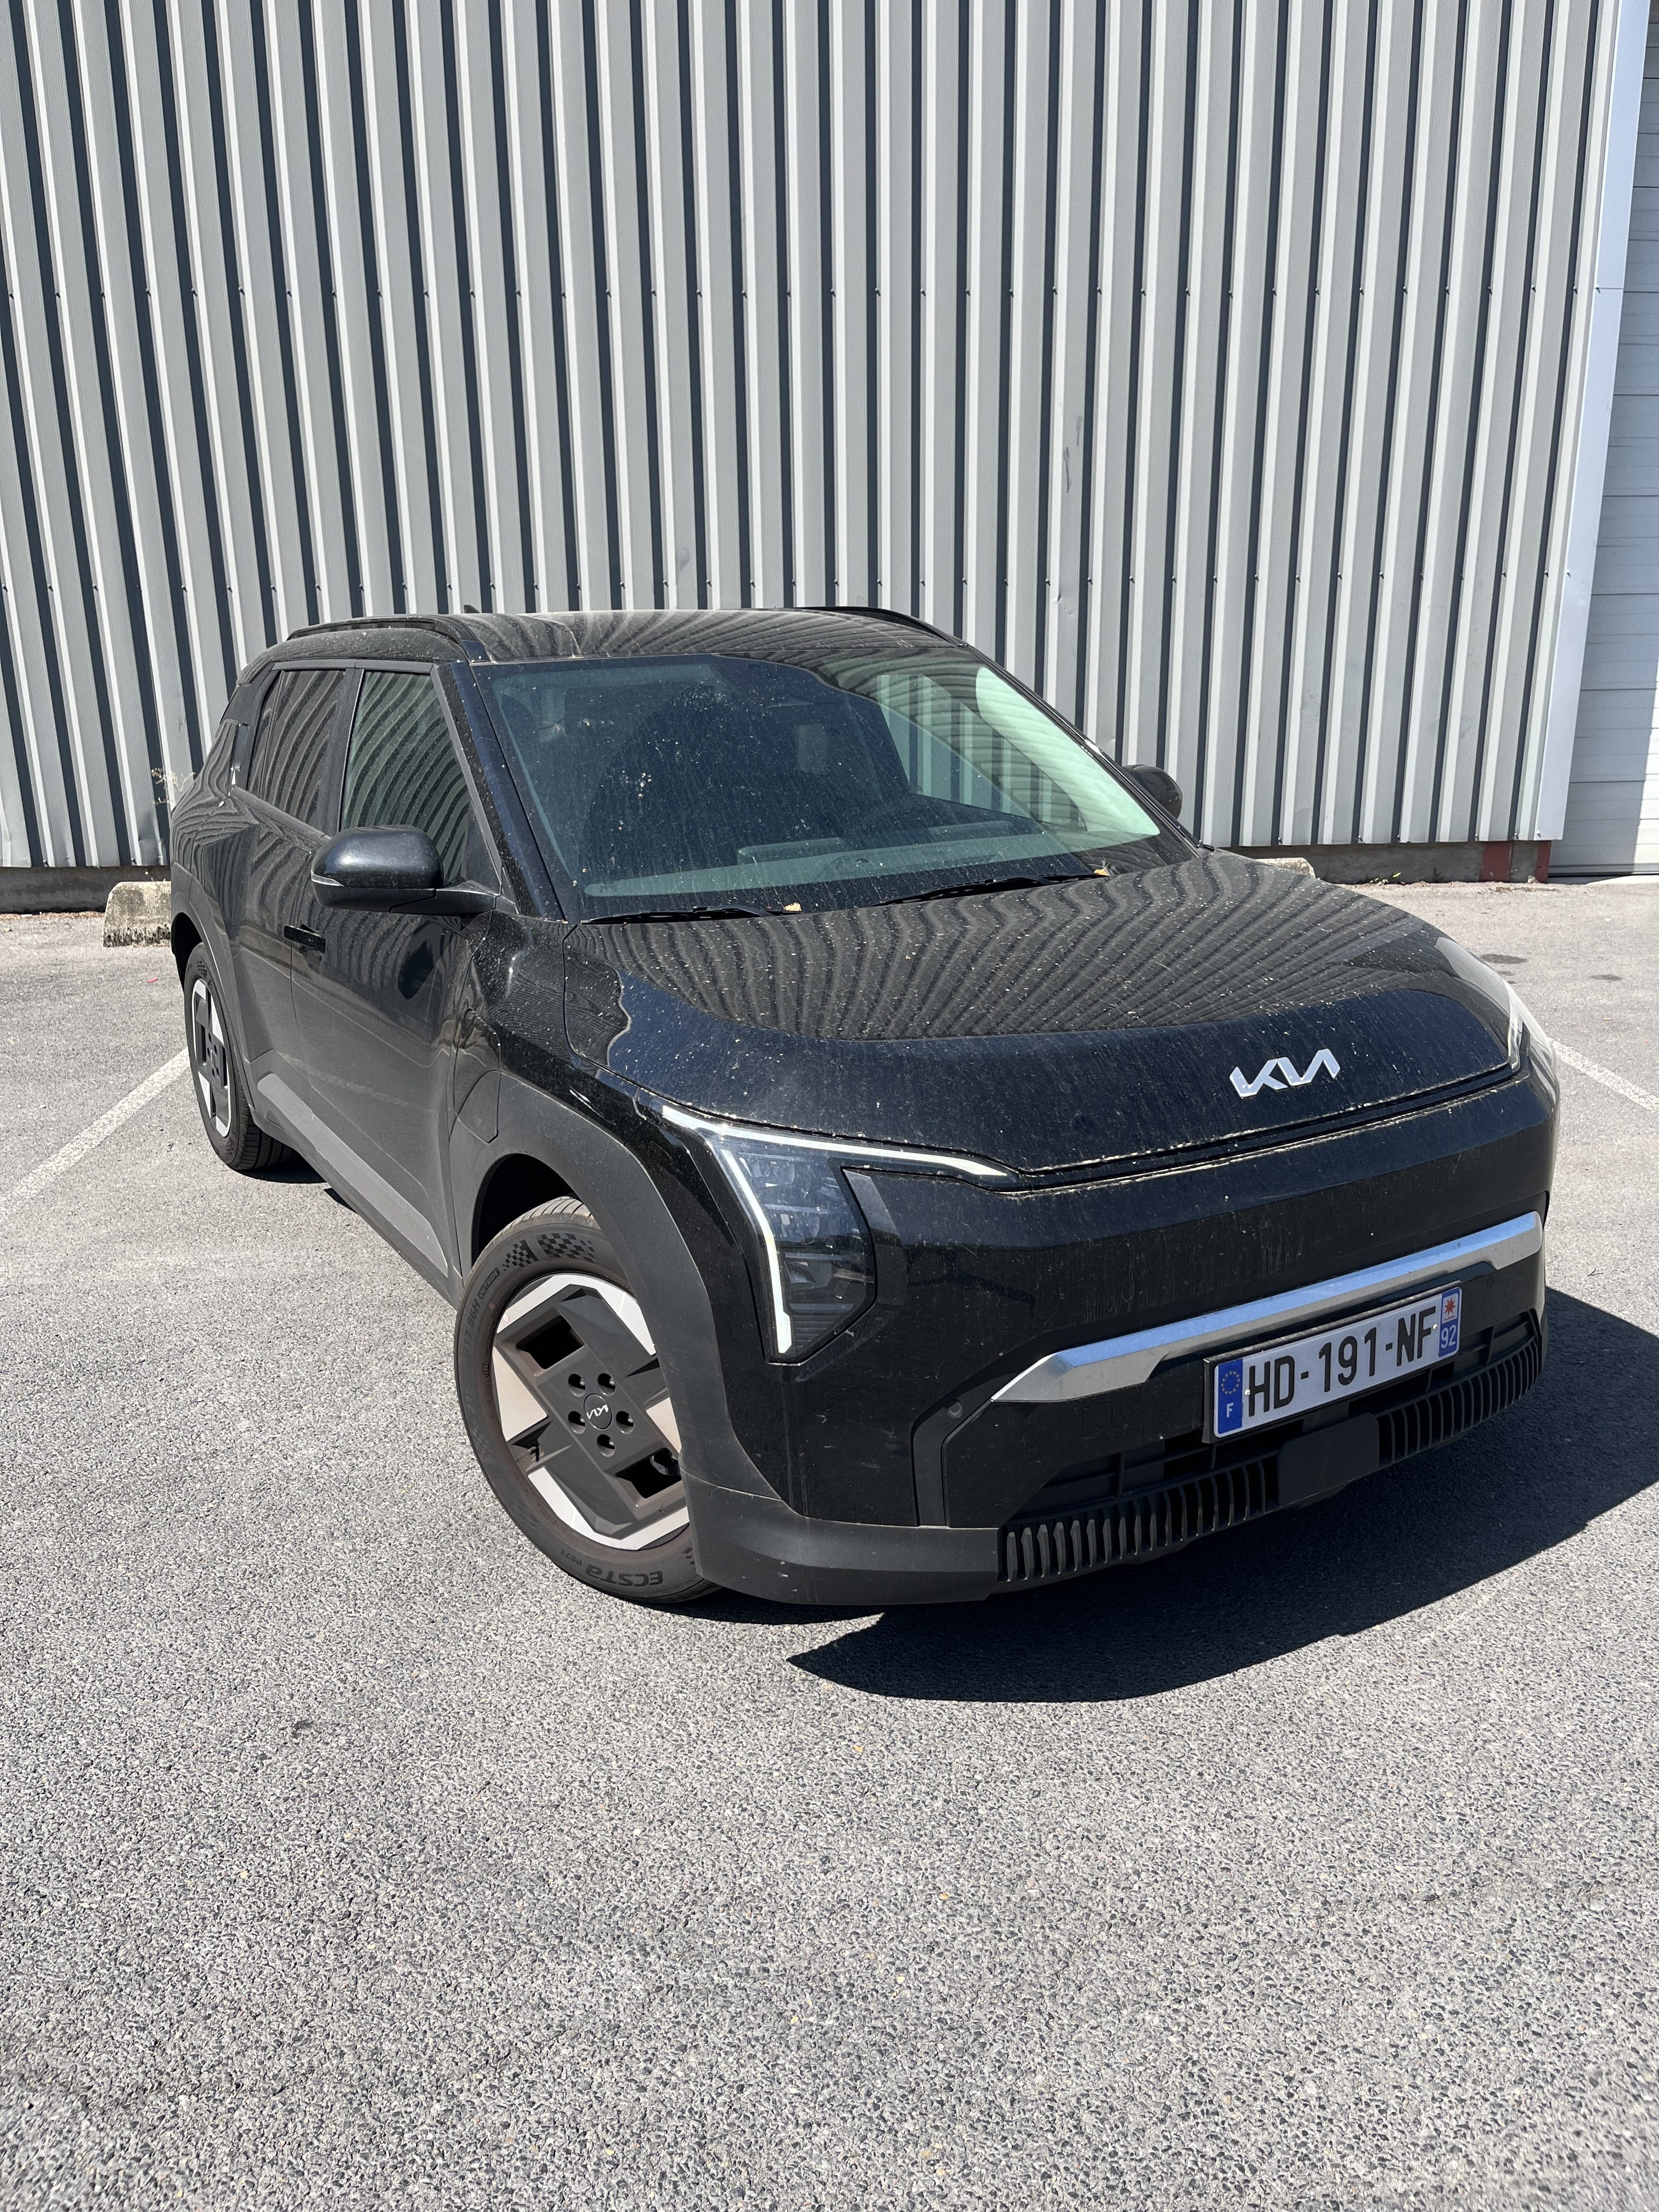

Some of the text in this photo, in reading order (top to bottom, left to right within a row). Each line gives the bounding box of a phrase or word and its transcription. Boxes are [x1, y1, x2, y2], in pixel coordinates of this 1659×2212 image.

[1229, 1048, 1340, 1099] KIA
[478, 1268, 499, 1299] OUTSIDE
[1441, 1324, 1457, 1348] 92
[1249, 1306, 1436, 1417] HD-191-NF
[586, 1404, 609, 1419] KIA
[1226, 1402, 1234, 1418] F
[561, 1549, 583, 1566] PS71
